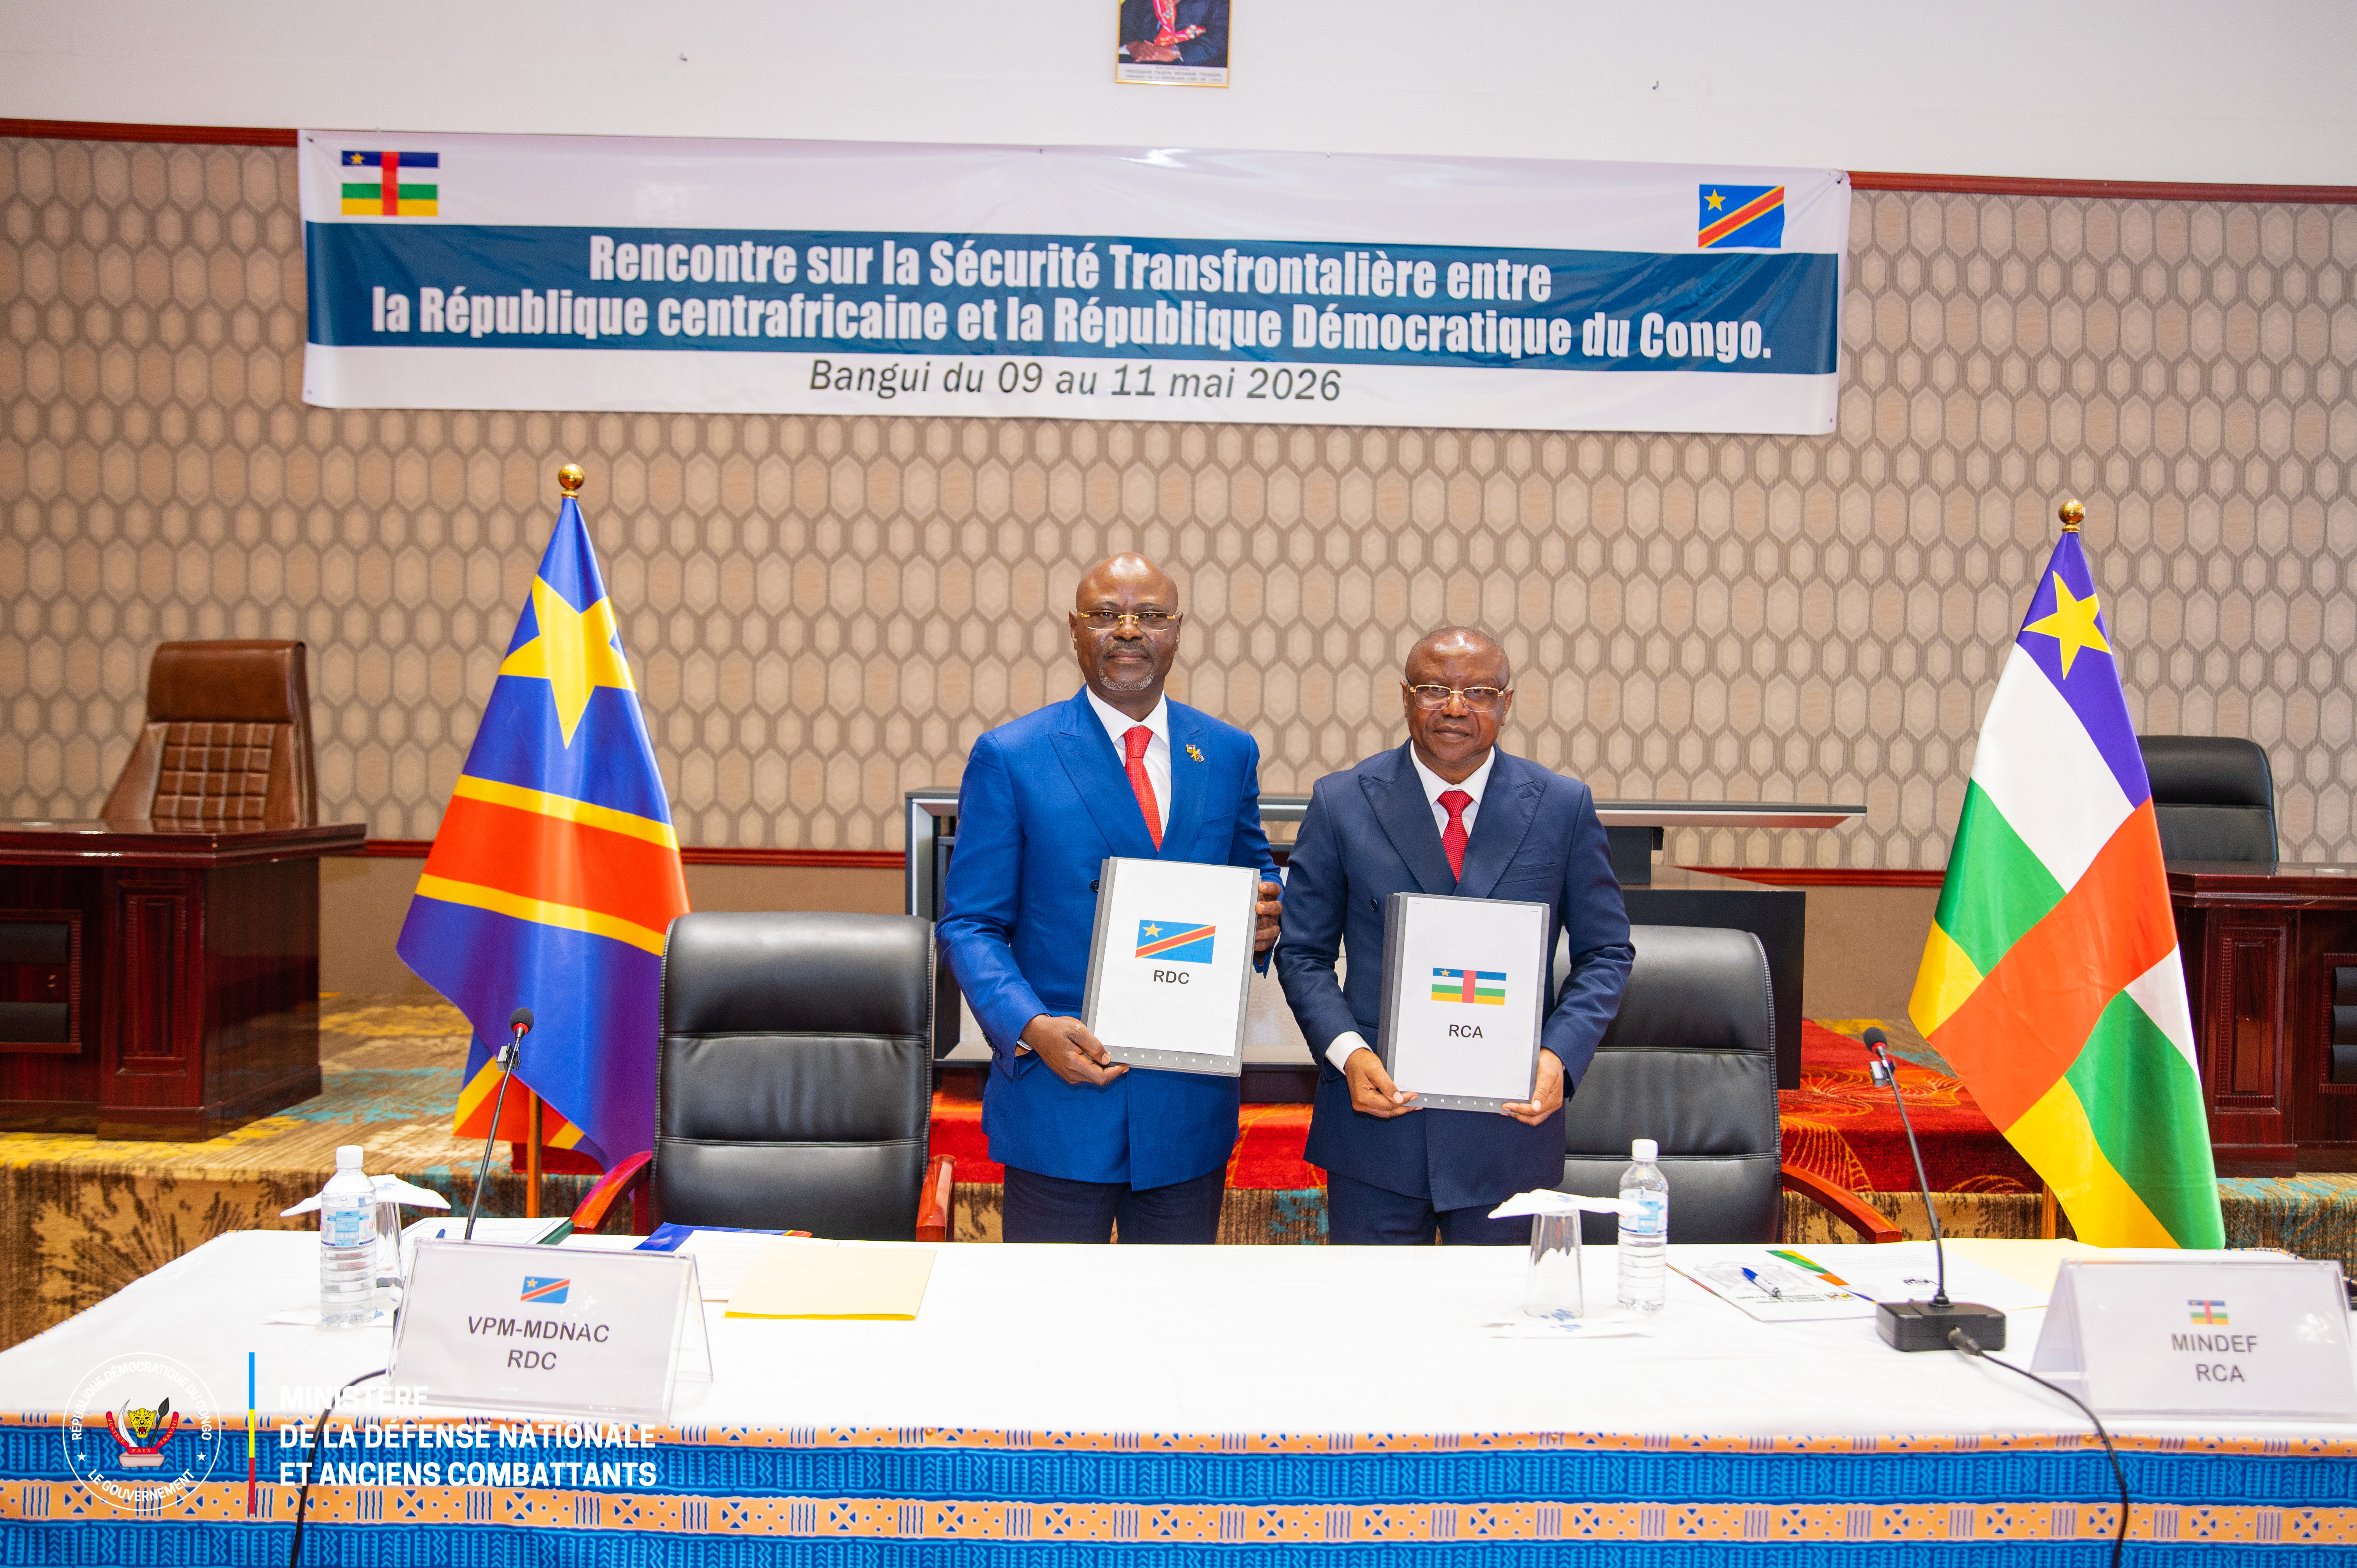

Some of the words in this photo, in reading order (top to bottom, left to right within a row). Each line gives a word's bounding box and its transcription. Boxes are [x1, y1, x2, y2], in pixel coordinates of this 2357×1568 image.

[590, 235, 797, 284] Rencontre
[807, 245, 874, 284] sur
[882, 240, 920, 286] la
[930, 240, 1100, 289] Sécurité
[1109, 244, 1436, 300] Transfrontalière
[1447, 259, 1551, 302] entre
[372, 286, 410, 332] la
[419, 286, 648, 339] République
[657, 293, 947, 340] centrafricaine
[957, 298, 998, 341] et
[1006, 297, 1044, 342] la
[1054, 297, 1282, 351] République
[1292, 303, 1572, 359] Démocratique
[1582, 312, 1631, 358] du
[1640, 312, 1772, 364] Congo.
[809, 359, 931, 400] Bangui
[943, 362, 984, 393] du
[998, 361, 1043, 394] 09
[1055, 370, 1097, 396] au
[1110, 364, 1156, 397] 11
[1168, 367, 1236, 398] mai
[1246, 367, 1342, 402] 2026
[1153, 969, 1190, 985] RDC
[1449, 1024, 1483, 1039] RCA
[1108, 1051, 1230, 1066] IGNATURE
[468, 1315, 610, 1343] VPM-MDNAC
[2171, 1333, 2257, 1353] MINDEF
[507, 1349, 557, 1370] RDC
[2195, 1363, 2246, 1383] RCA
